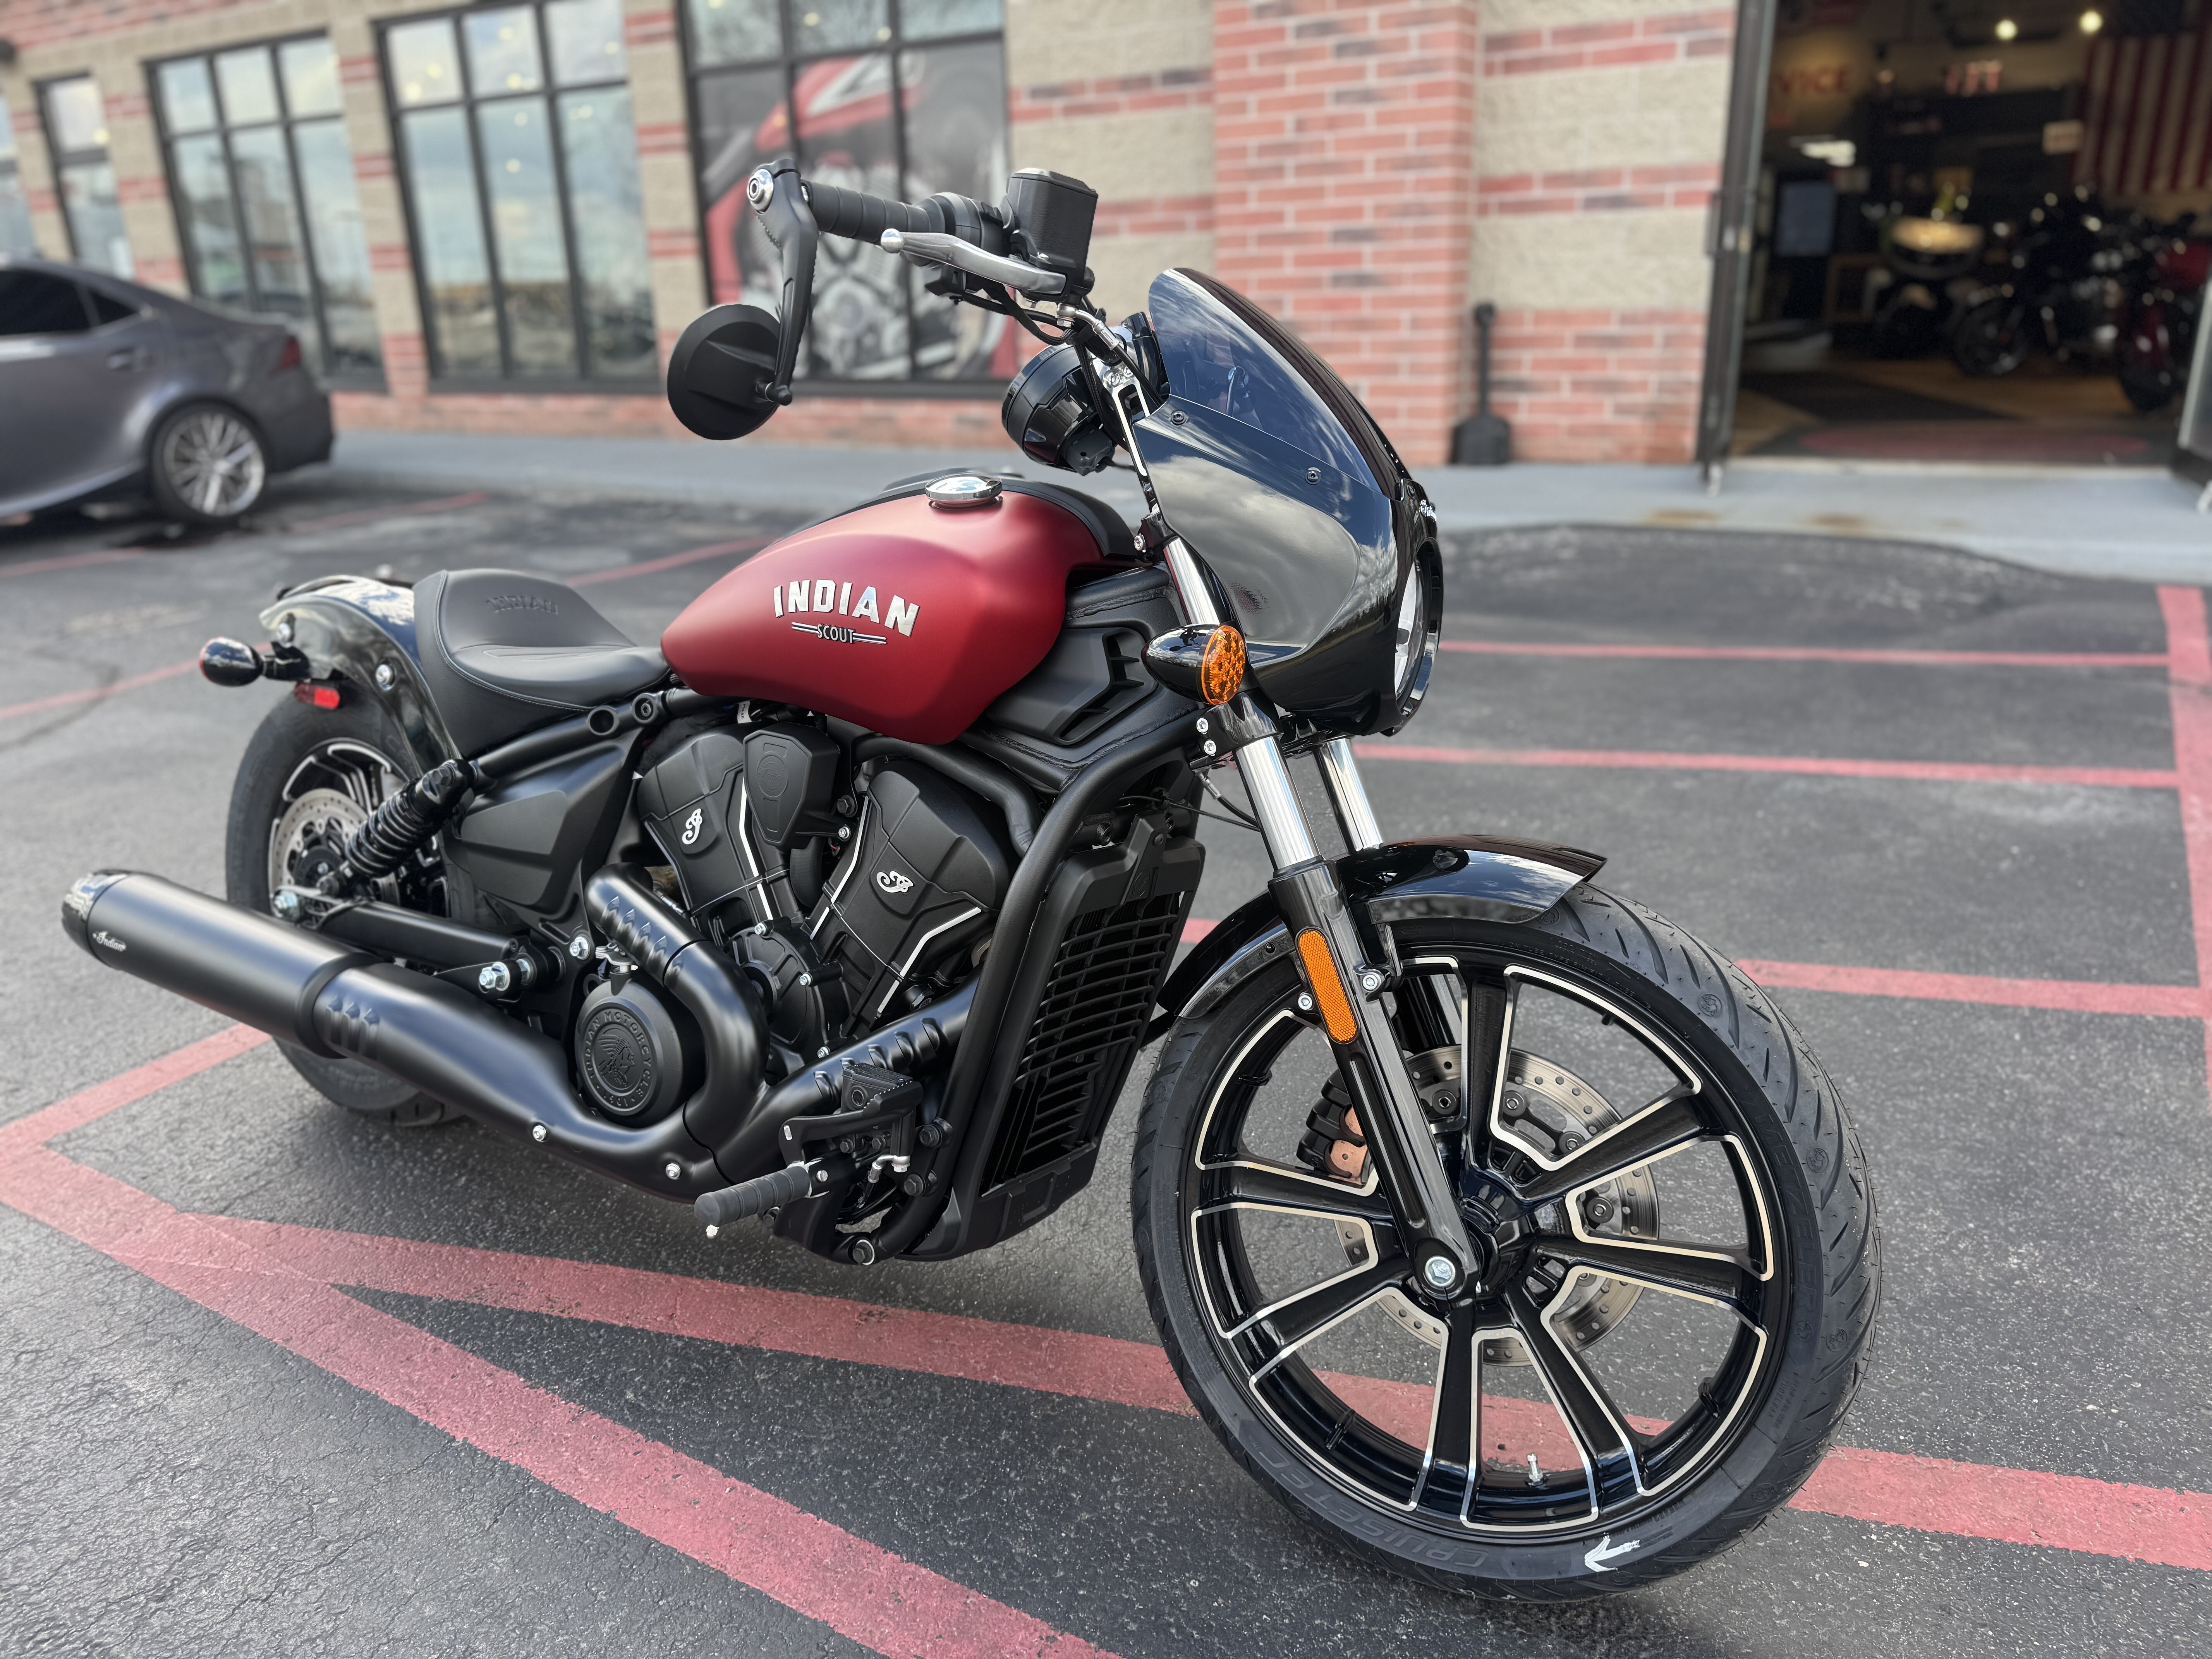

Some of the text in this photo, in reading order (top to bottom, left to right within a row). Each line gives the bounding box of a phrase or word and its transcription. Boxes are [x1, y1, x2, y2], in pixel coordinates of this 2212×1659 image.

[487, 596, 558, 615] INDIAN
[774, 579, 920, 637] INDIAN
[817, 624, 854, 643] SCOUT
[93, 931, 126, 952] Indian
[1524, 945, 1544, 955] TUBE
[1549, 952, 1570, 963] TYPE
[1573, 961, 1587, 972] RIM
[1615, 981, 1635, 997] TUBE
[584, 1011, 653, 1097] INDIAN MOTORCYCLE
[603, 1090, 629, 1107] 1901
[1754, 1113, 1817, 1312] METZELER
[1259, 1445, 1489, 1567] CRUISETEC
